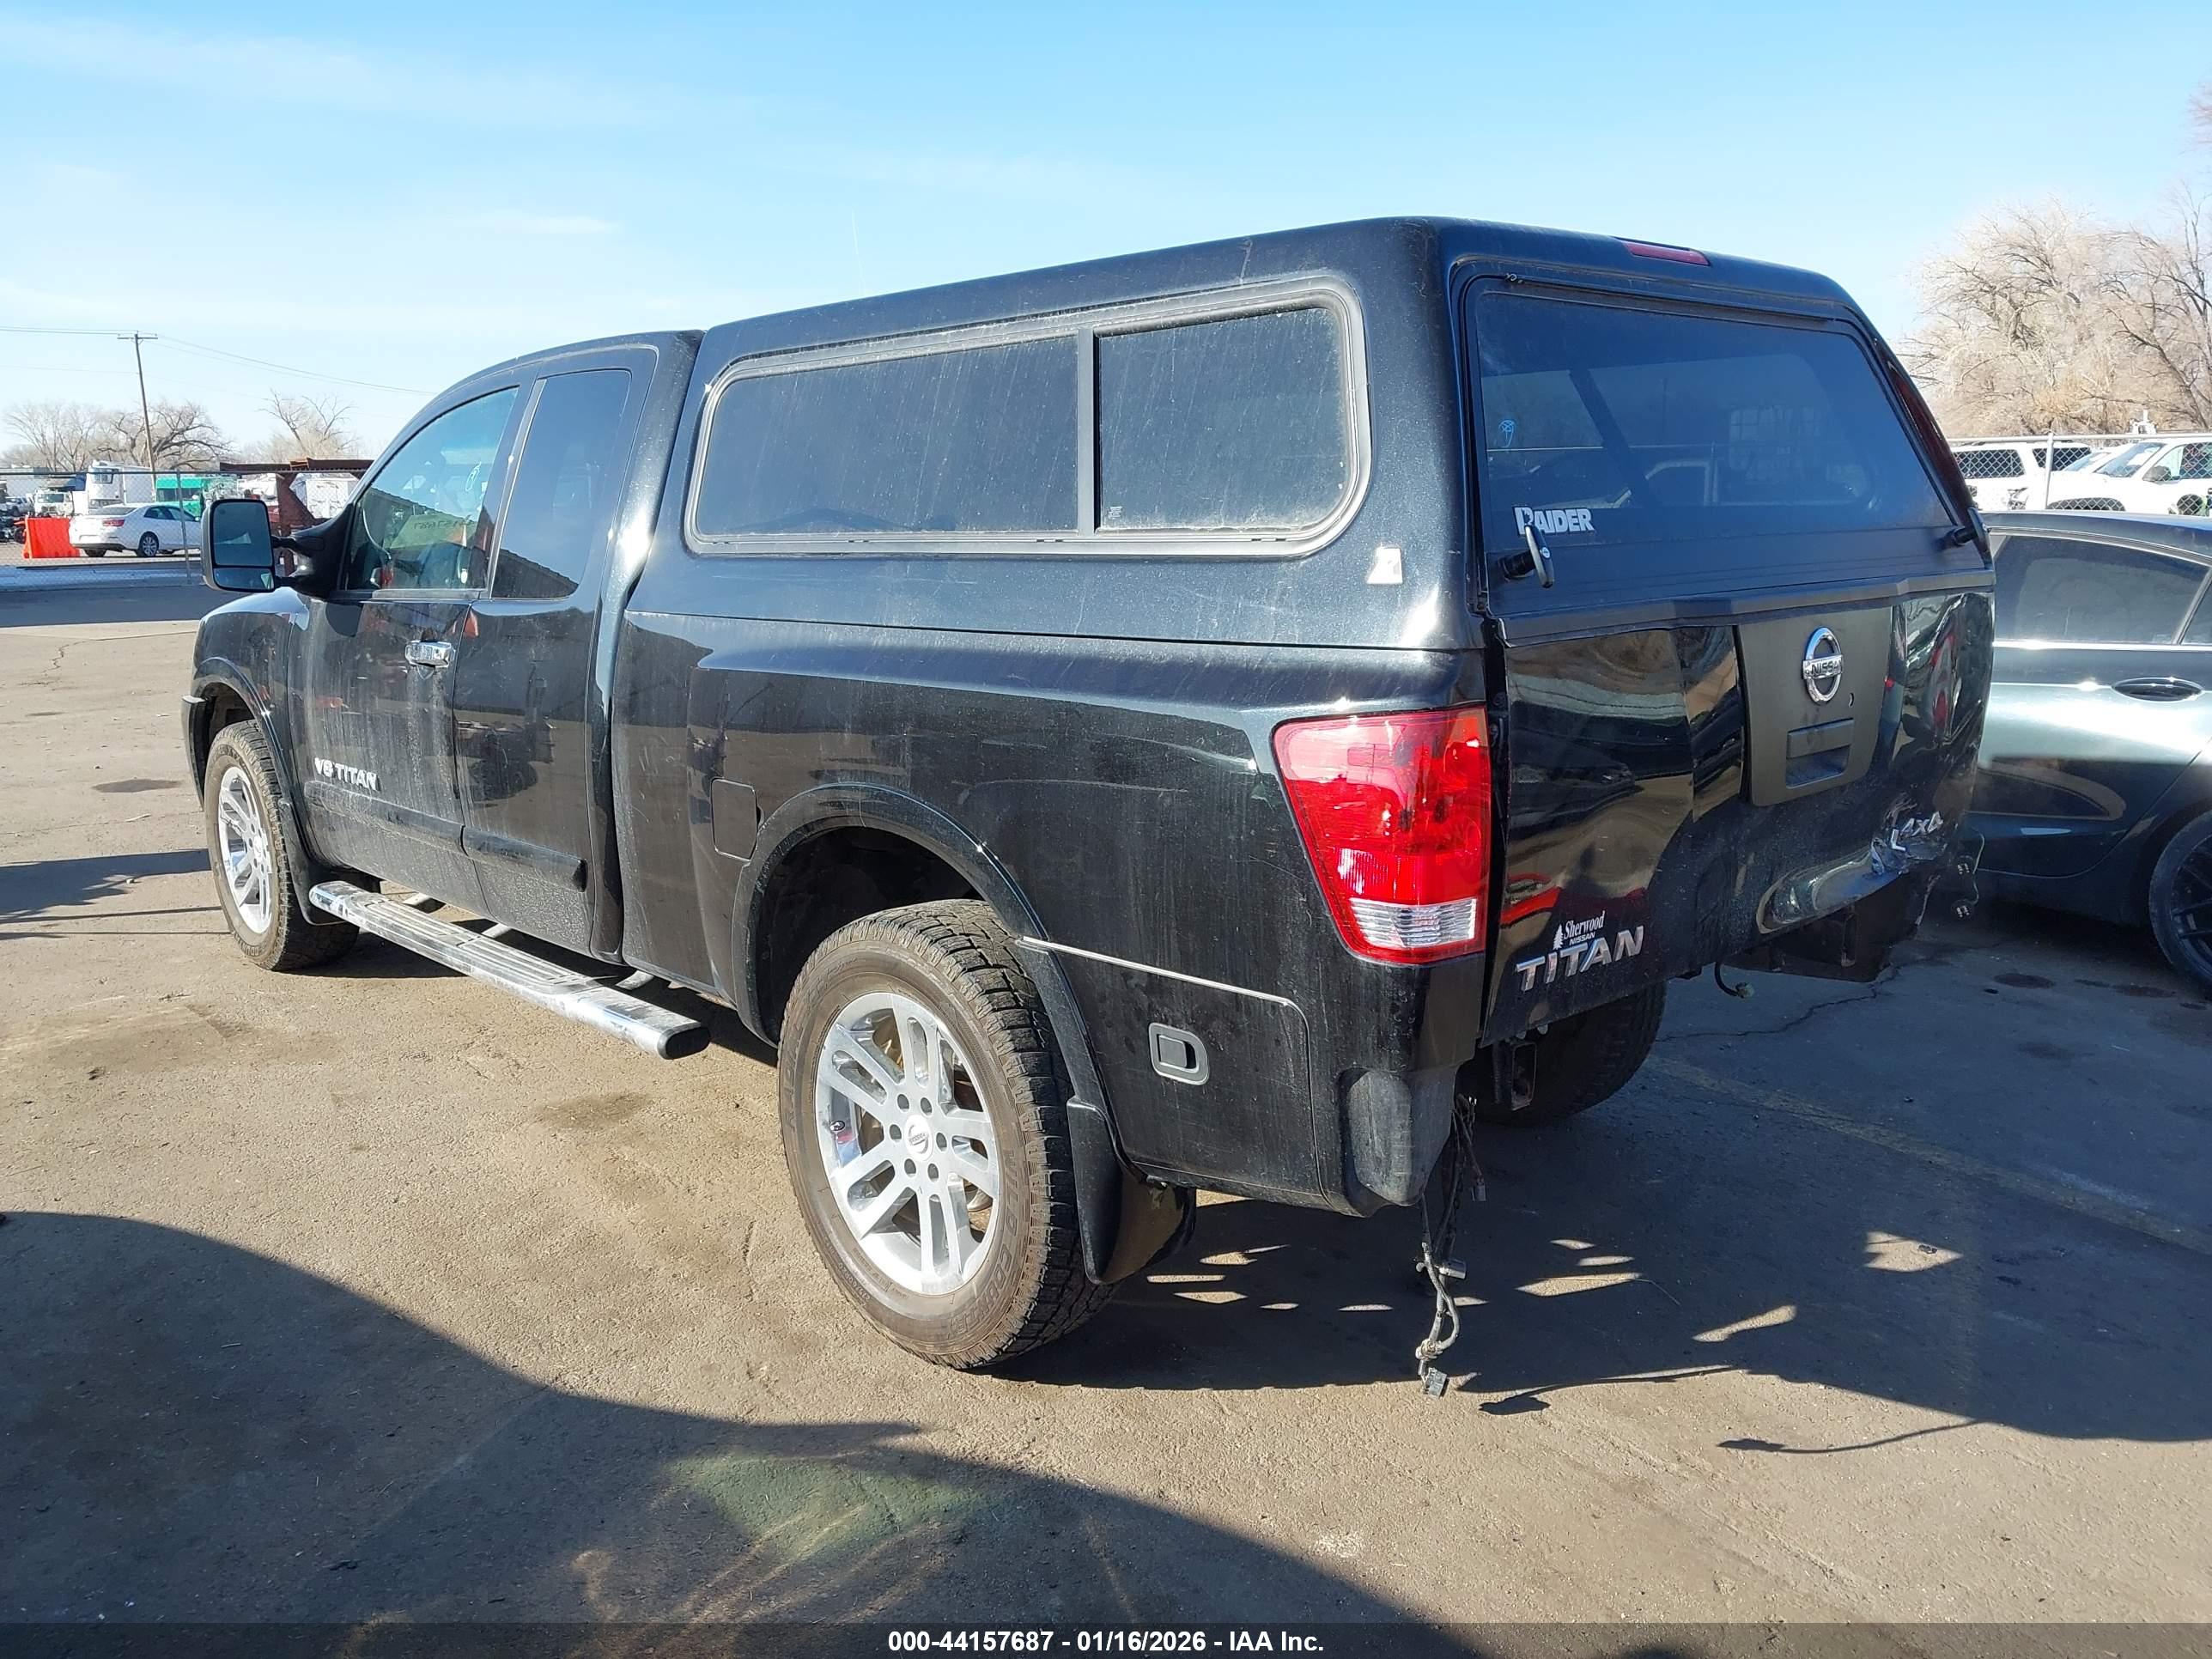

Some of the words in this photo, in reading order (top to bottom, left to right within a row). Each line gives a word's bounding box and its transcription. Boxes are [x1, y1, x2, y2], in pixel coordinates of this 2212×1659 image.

[1514, 507, 1595, 535] RAIDER
[314, 757, 333, 778] V8
[334, 763, 378, 791] TITAN
[1563, 910, 1606, 940] Sherwood
[1569, 931, 1595, 945] NISSAN
[1515, 925, 1644, 992] TITAN
